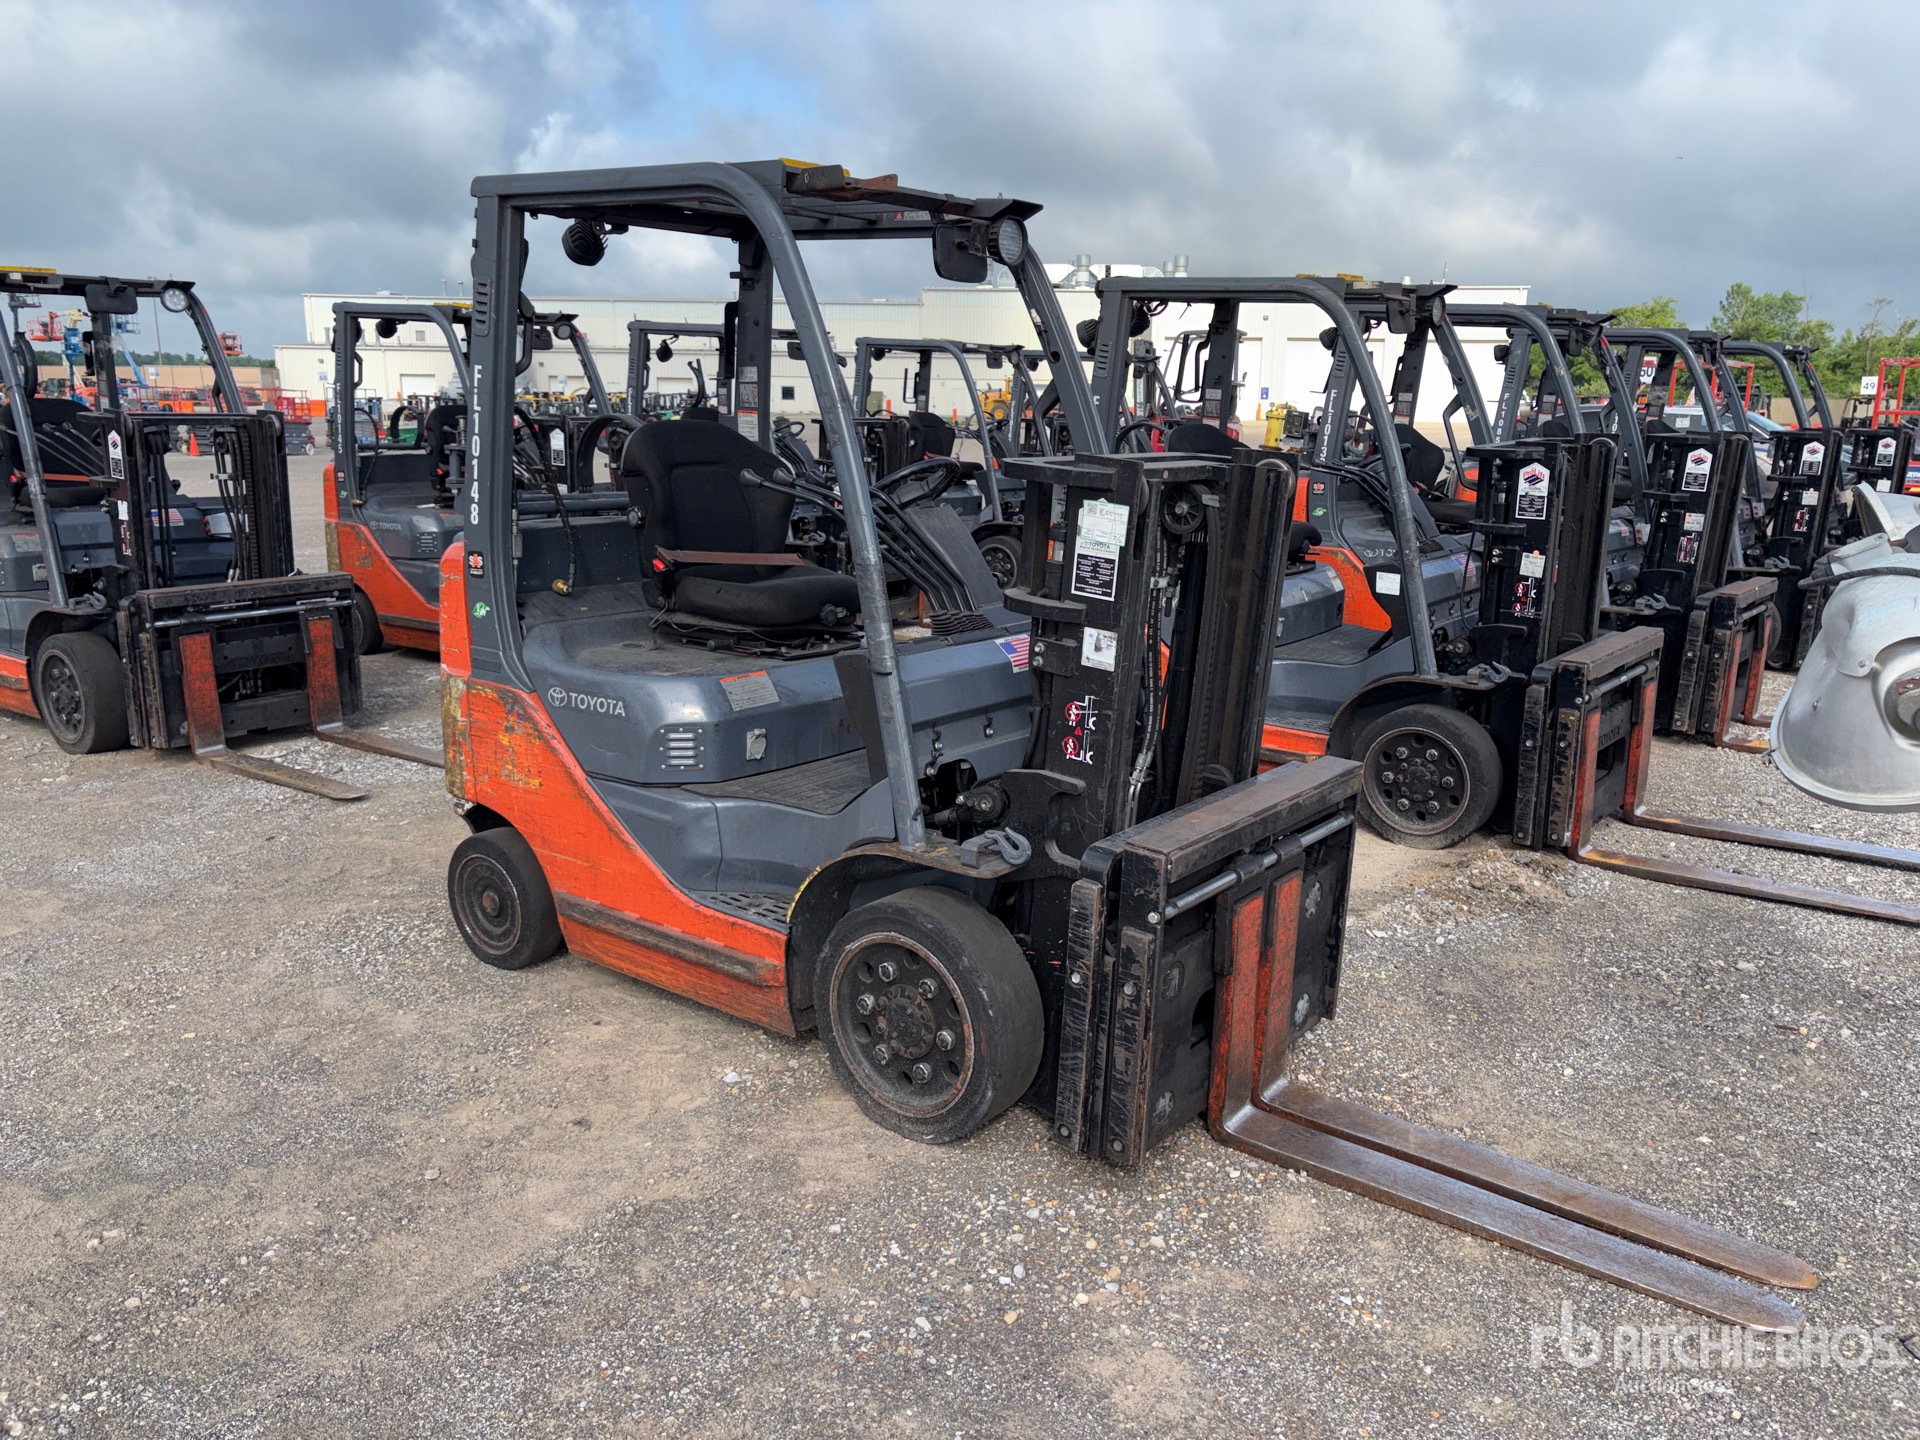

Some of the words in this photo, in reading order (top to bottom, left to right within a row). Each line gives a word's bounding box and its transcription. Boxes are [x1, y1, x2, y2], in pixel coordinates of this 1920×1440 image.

[1862, 382, 1876, 391] 49
[470, 364, 483, 525] FL10148
[379, 522, 402, 531] TOYOTA
[1089, 541, 1111, 550] TOYOTA
[569, 692, 626, 717] TOYOTA
